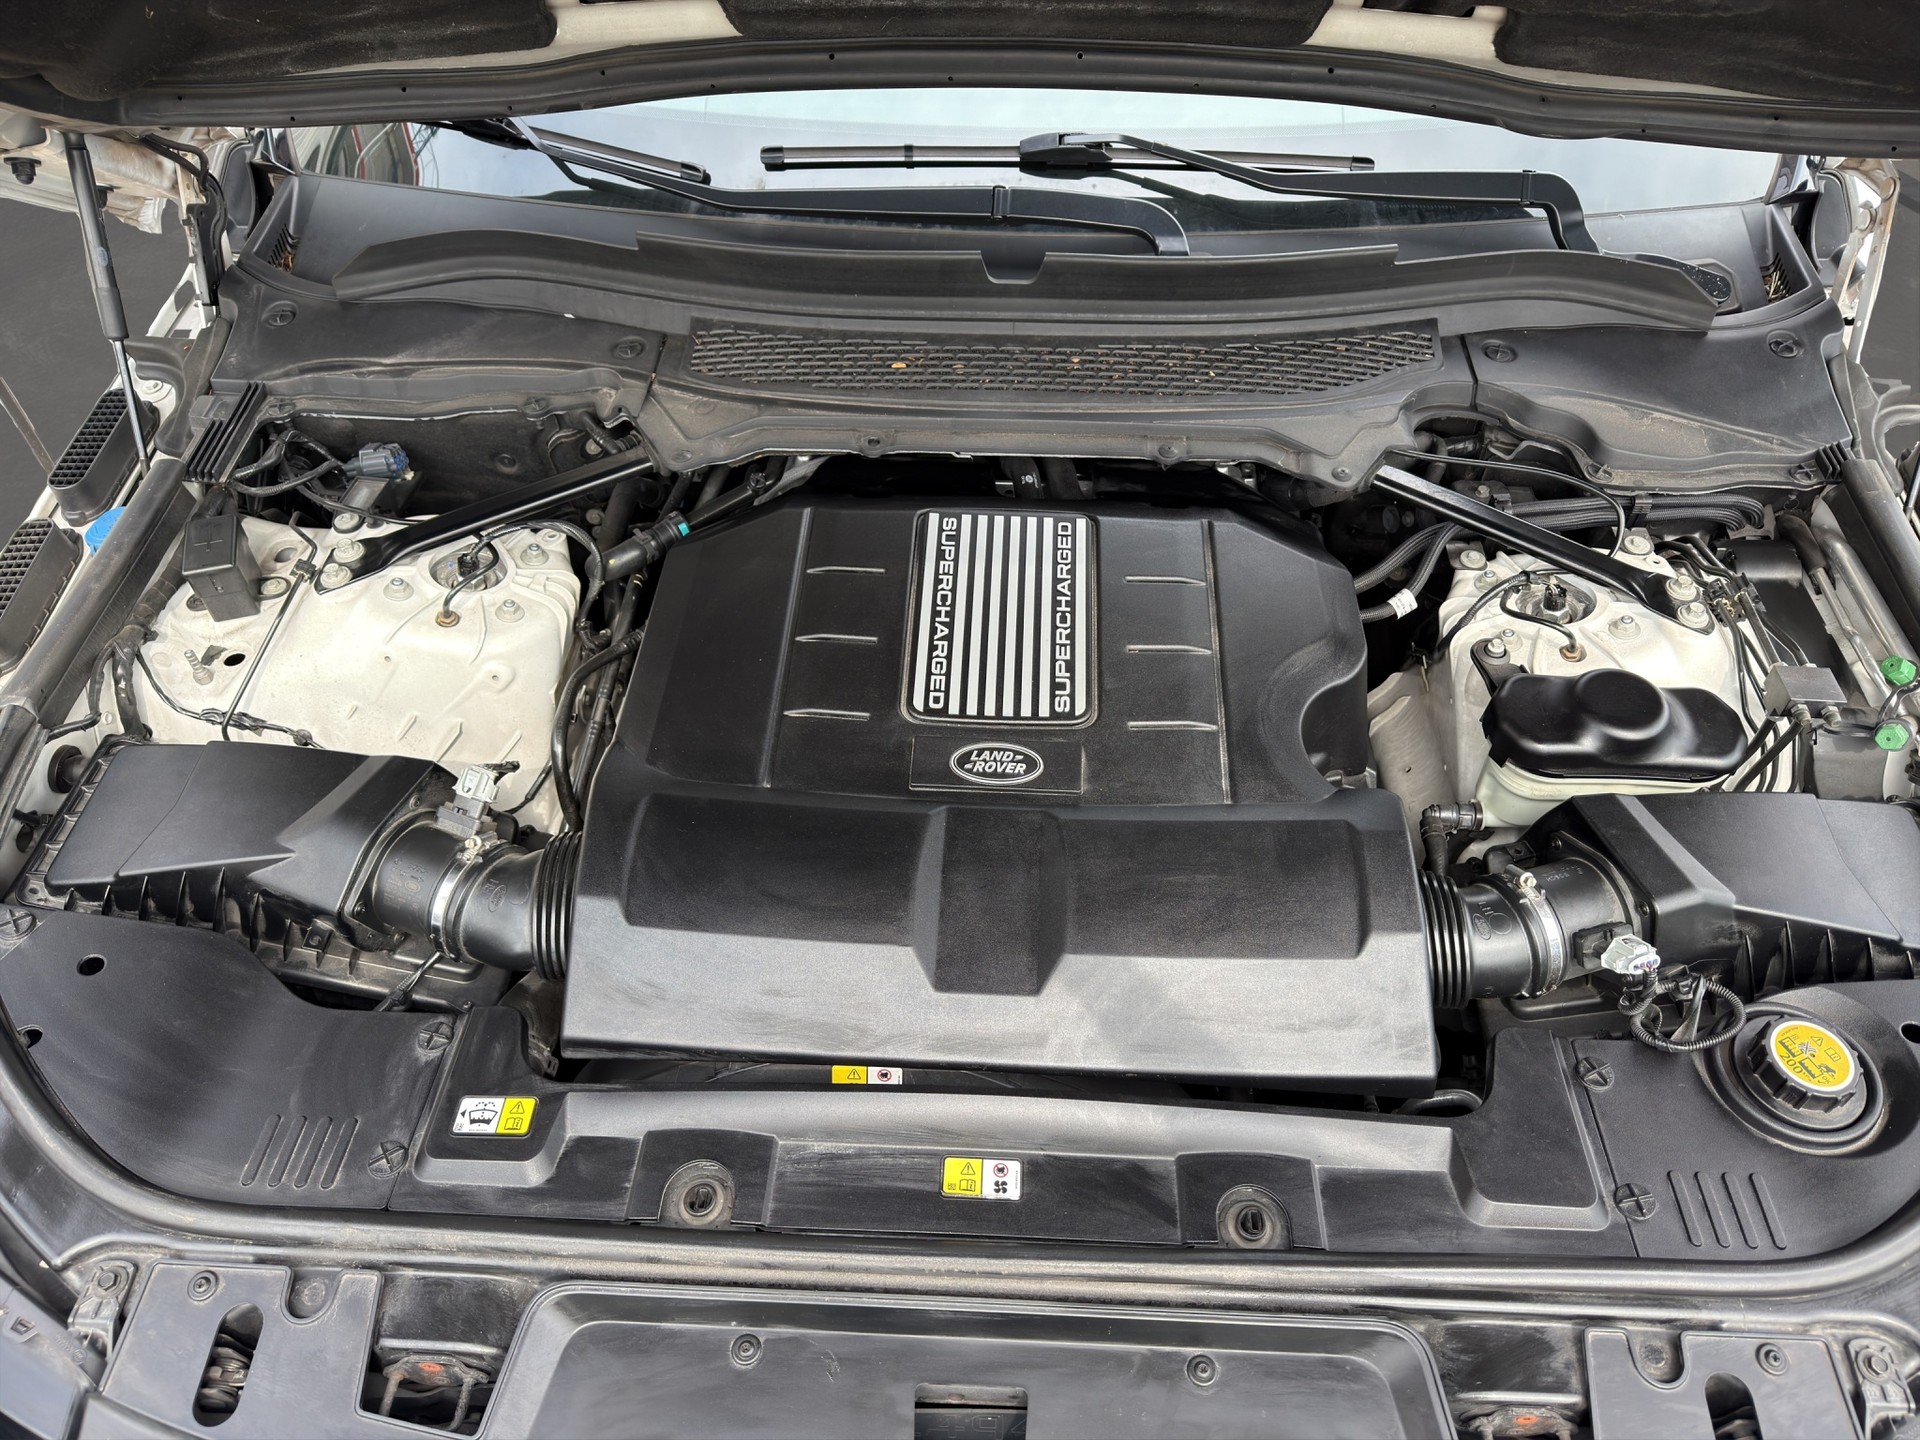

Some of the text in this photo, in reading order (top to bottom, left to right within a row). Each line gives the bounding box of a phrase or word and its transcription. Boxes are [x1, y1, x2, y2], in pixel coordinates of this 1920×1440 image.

[928, 516, 958, 710] SUPERCHARGED
[1054, 521, 1073, 713] SUPERCHARGED
[970, 750, 1014, 762] LAND
[972, 761, 1027, 774] ROVER
[1780, 1053, 1803, 1075] 200
